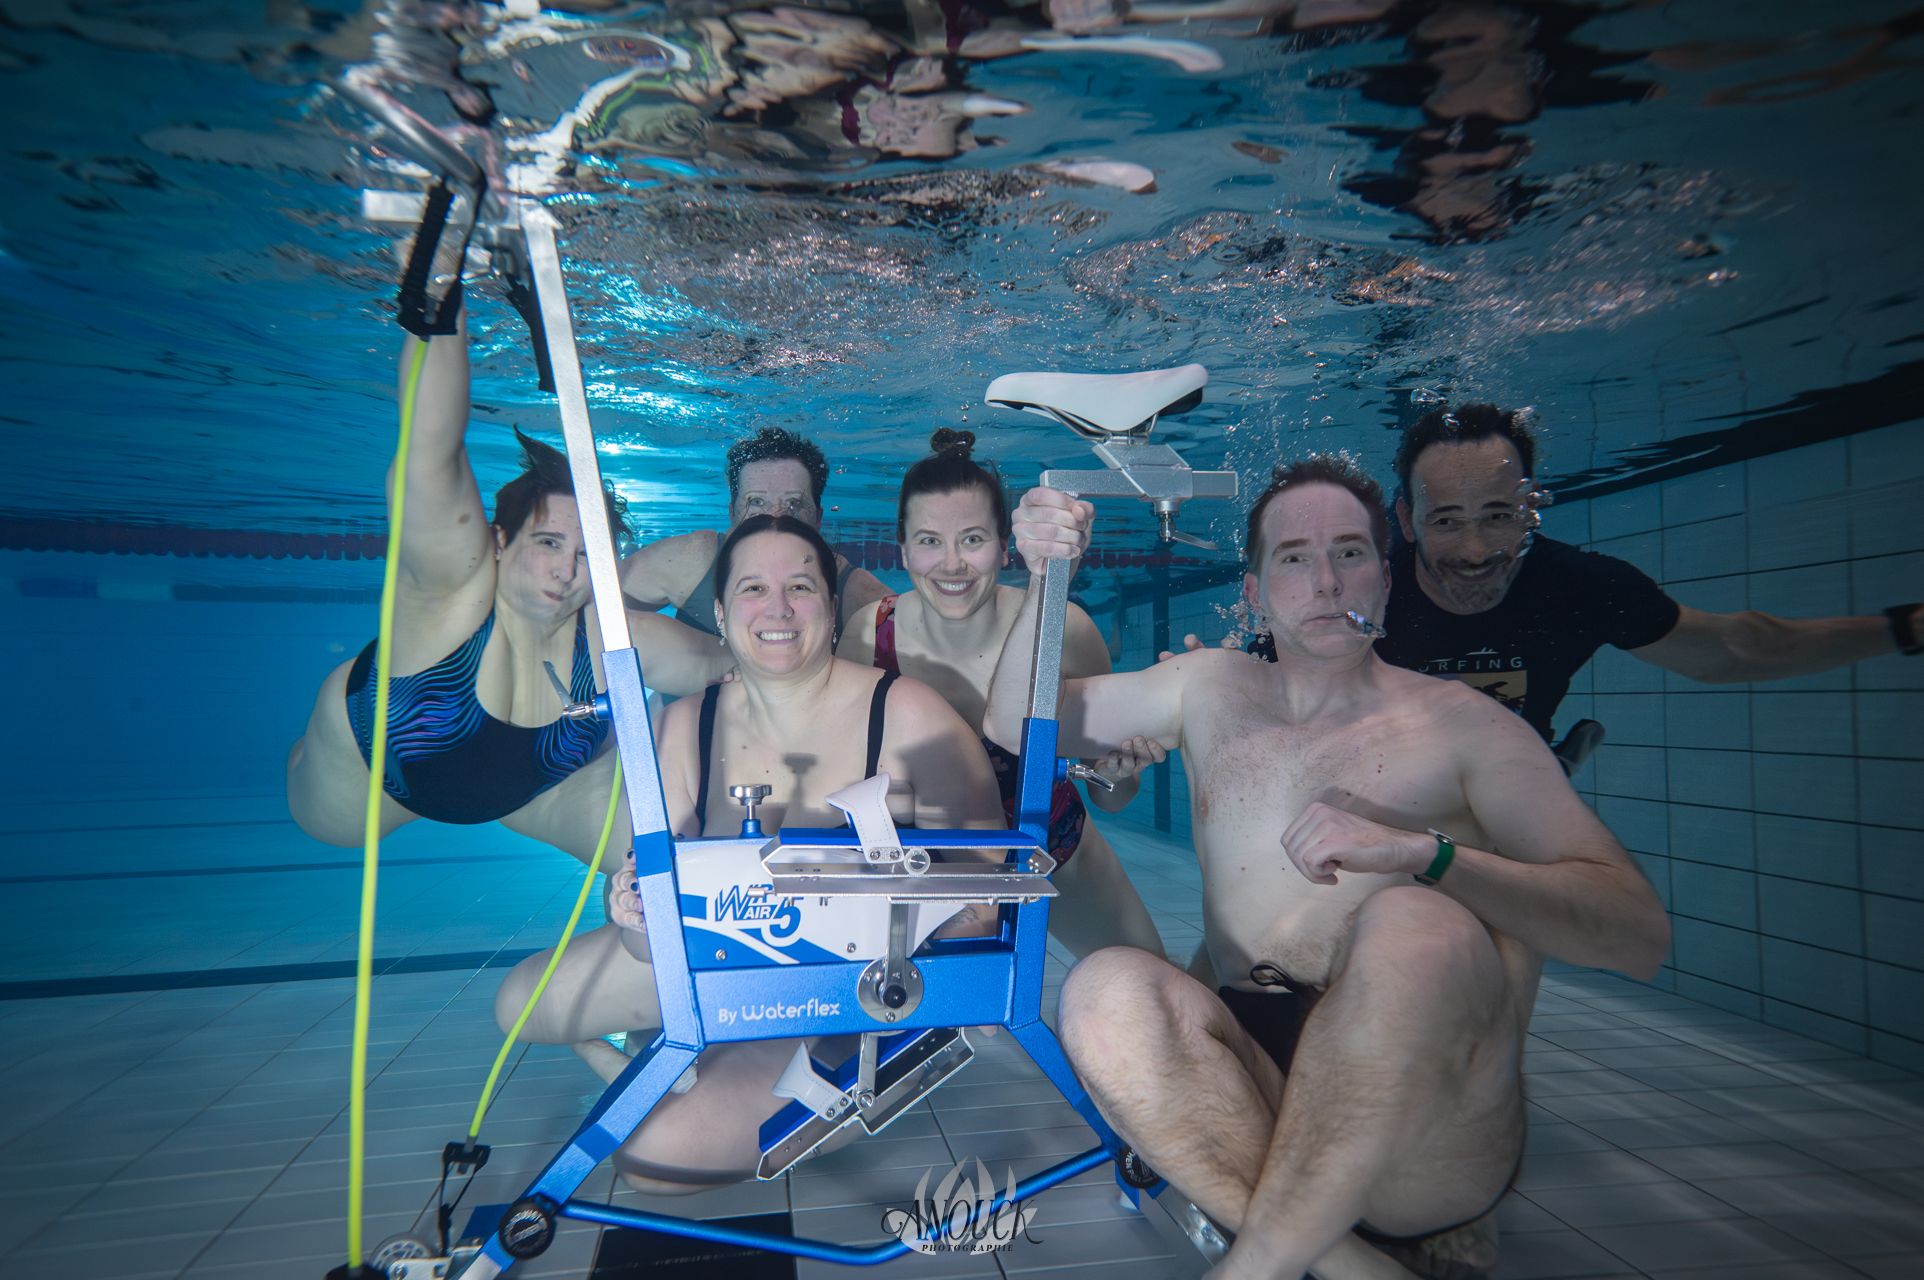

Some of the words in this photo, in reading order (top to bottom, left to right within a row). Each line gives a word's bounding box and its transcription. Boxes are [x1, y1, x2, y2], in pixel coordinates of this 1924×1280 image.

[1407, 656, 1523, 673] URFING
[743, 906, 771, 919] AIR
[718, 1008, 737, 1025] By
[741, 998, 840, 1021] Waterflex
